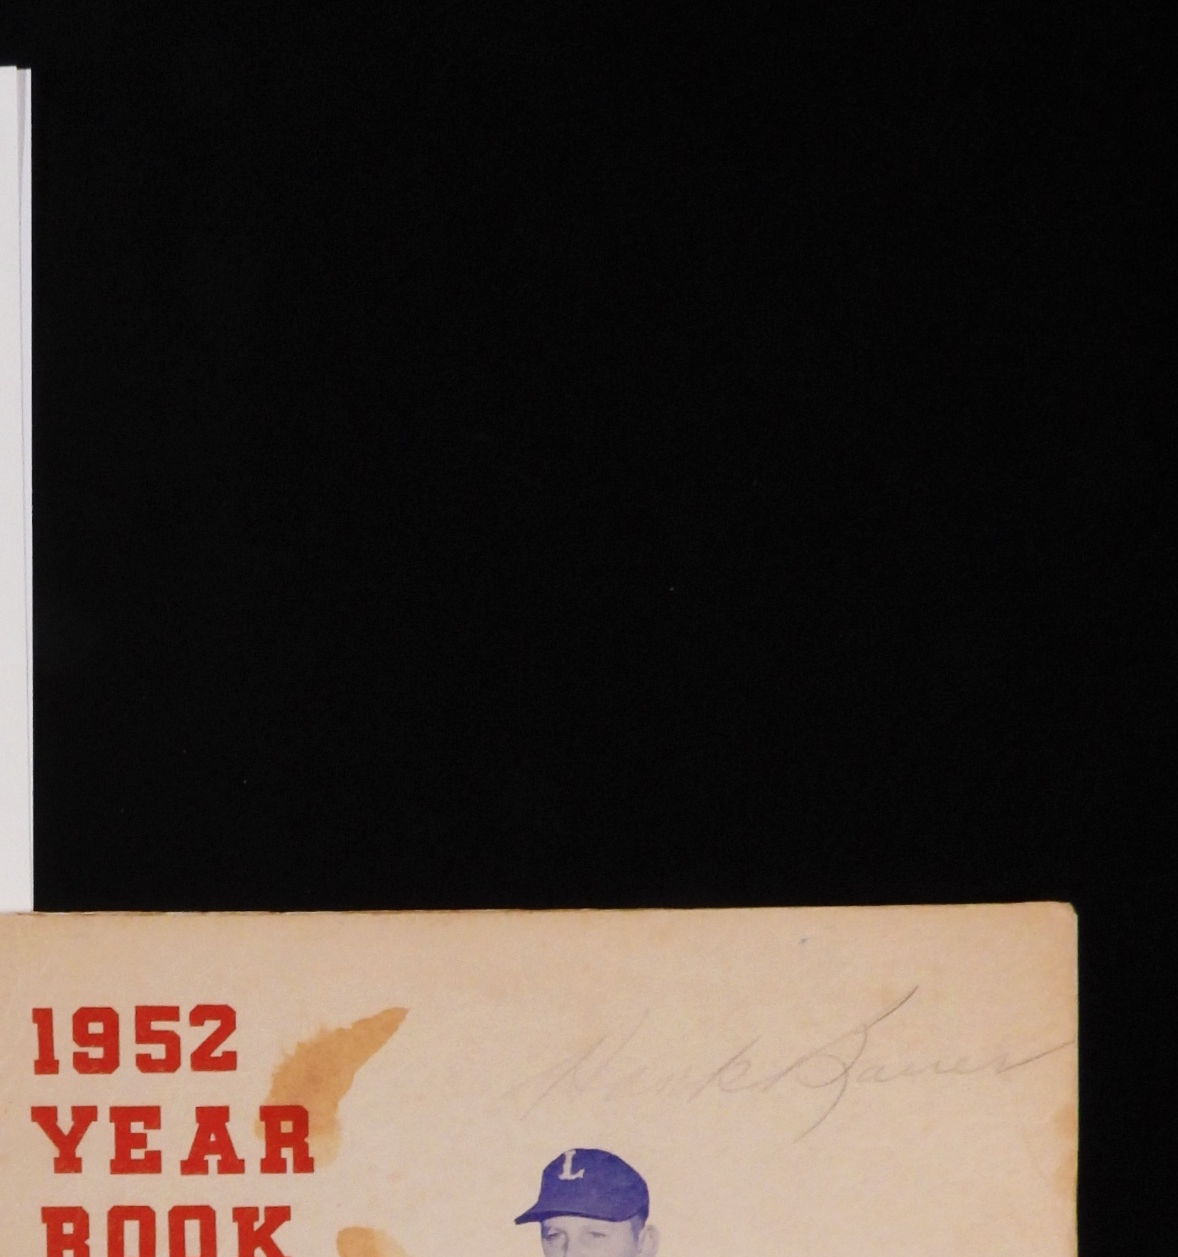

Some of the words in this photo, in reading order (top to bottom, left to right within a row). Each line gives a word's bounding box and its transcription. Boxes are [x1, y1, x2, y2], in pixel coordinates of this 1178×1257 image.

[32, 1004, 238, 1075] 1952
[30, 1104, 315, 1176] YEAR
[558, 1150, 585, 1180] L
